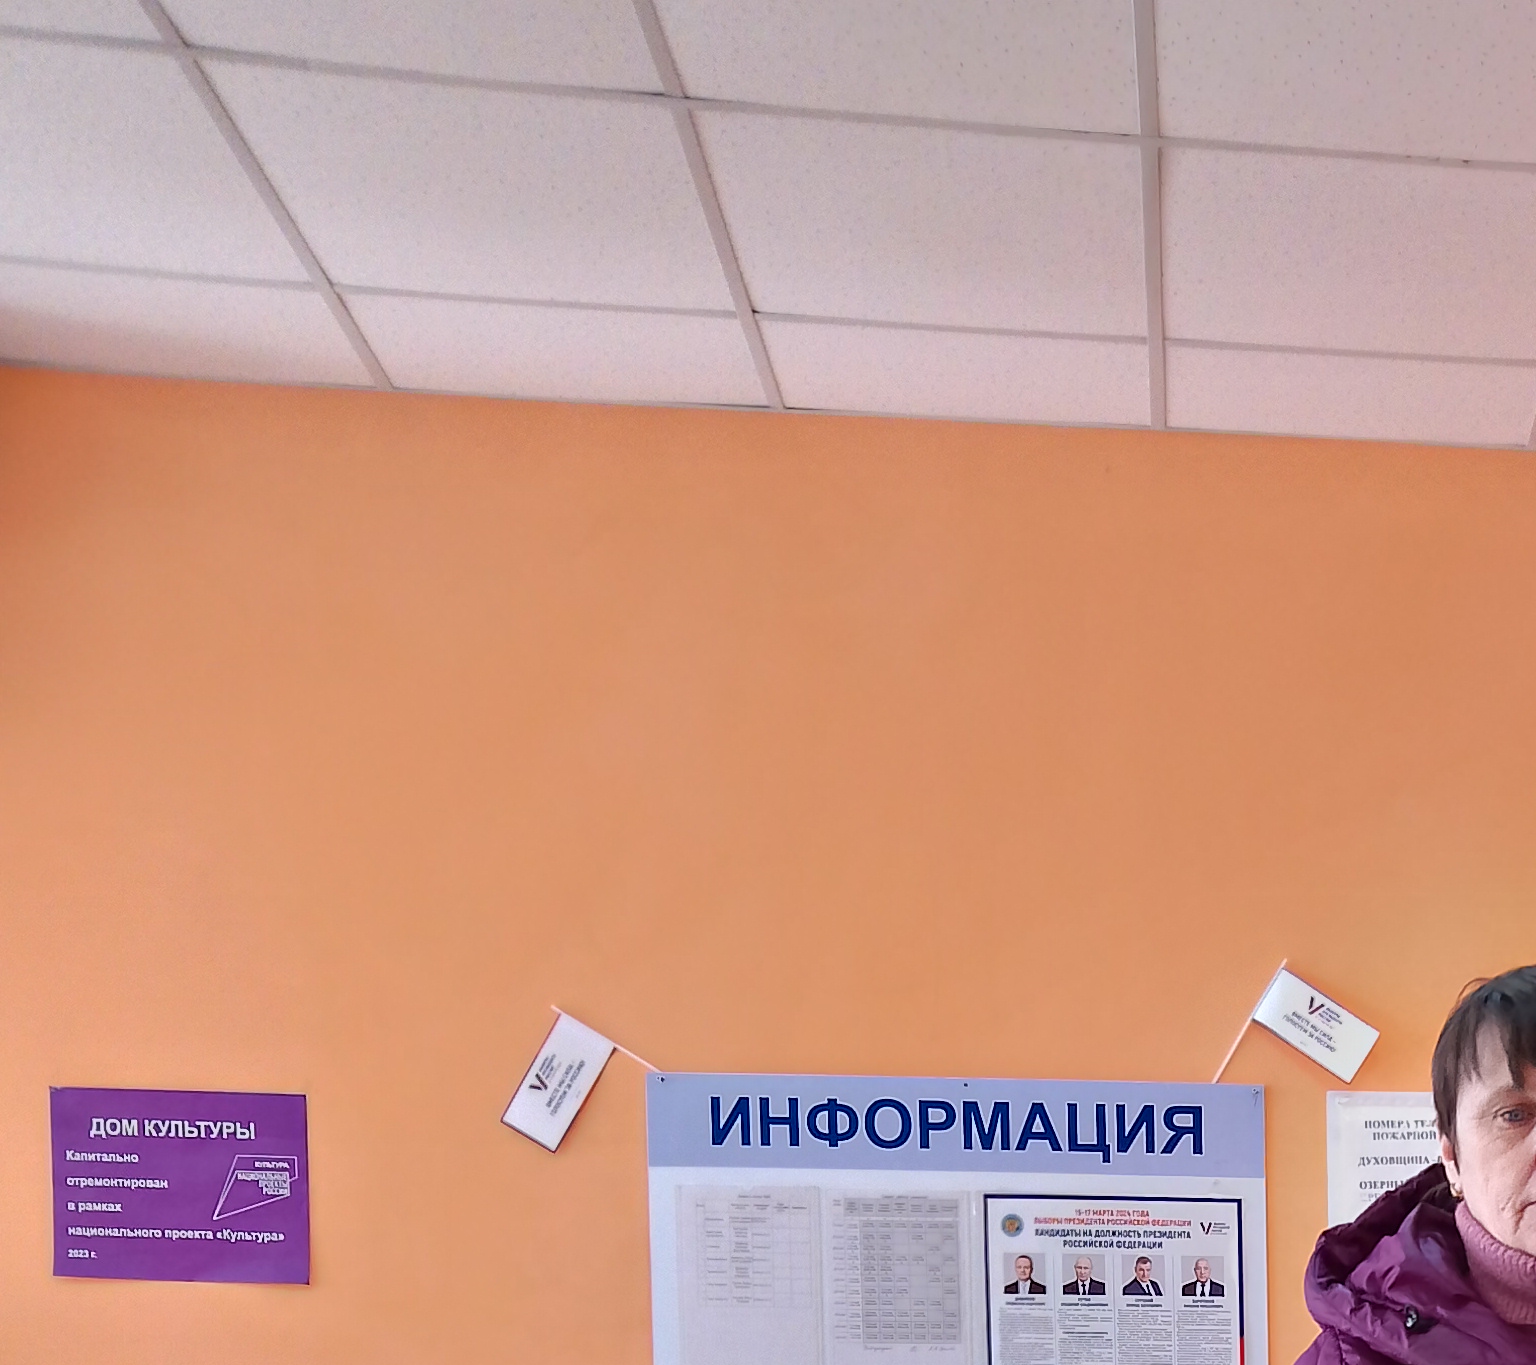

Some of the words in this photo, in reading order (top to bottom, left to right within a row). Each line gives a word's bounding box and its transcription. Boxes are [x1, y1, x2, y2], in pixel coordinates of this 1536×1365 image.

[89, 1118, 139, 1139] ДОМ
[143, 1119, 256, 1140] КУЛЬТУРЫ
[708, 1095, 1204, 1164] ИНФОРМАЦИЯ
[65, 1150, 140, 1164] Капитально
[66, 1176, 169, 1189] отремонтирован
[67, 1202, 76, 1212] в
[77, 1202, 123, 1213] рамках
[67, 1226, 162, 1240] национального
[164, 1228, 214, 1242] проекта
[216, 1228, 285, 1244] «Культура»
[1062, 1238, 1115, 1249] РОССИЙСКОЙ
[1115, 1240, 1163, 1250] ФЕДЕРАЦИИ
